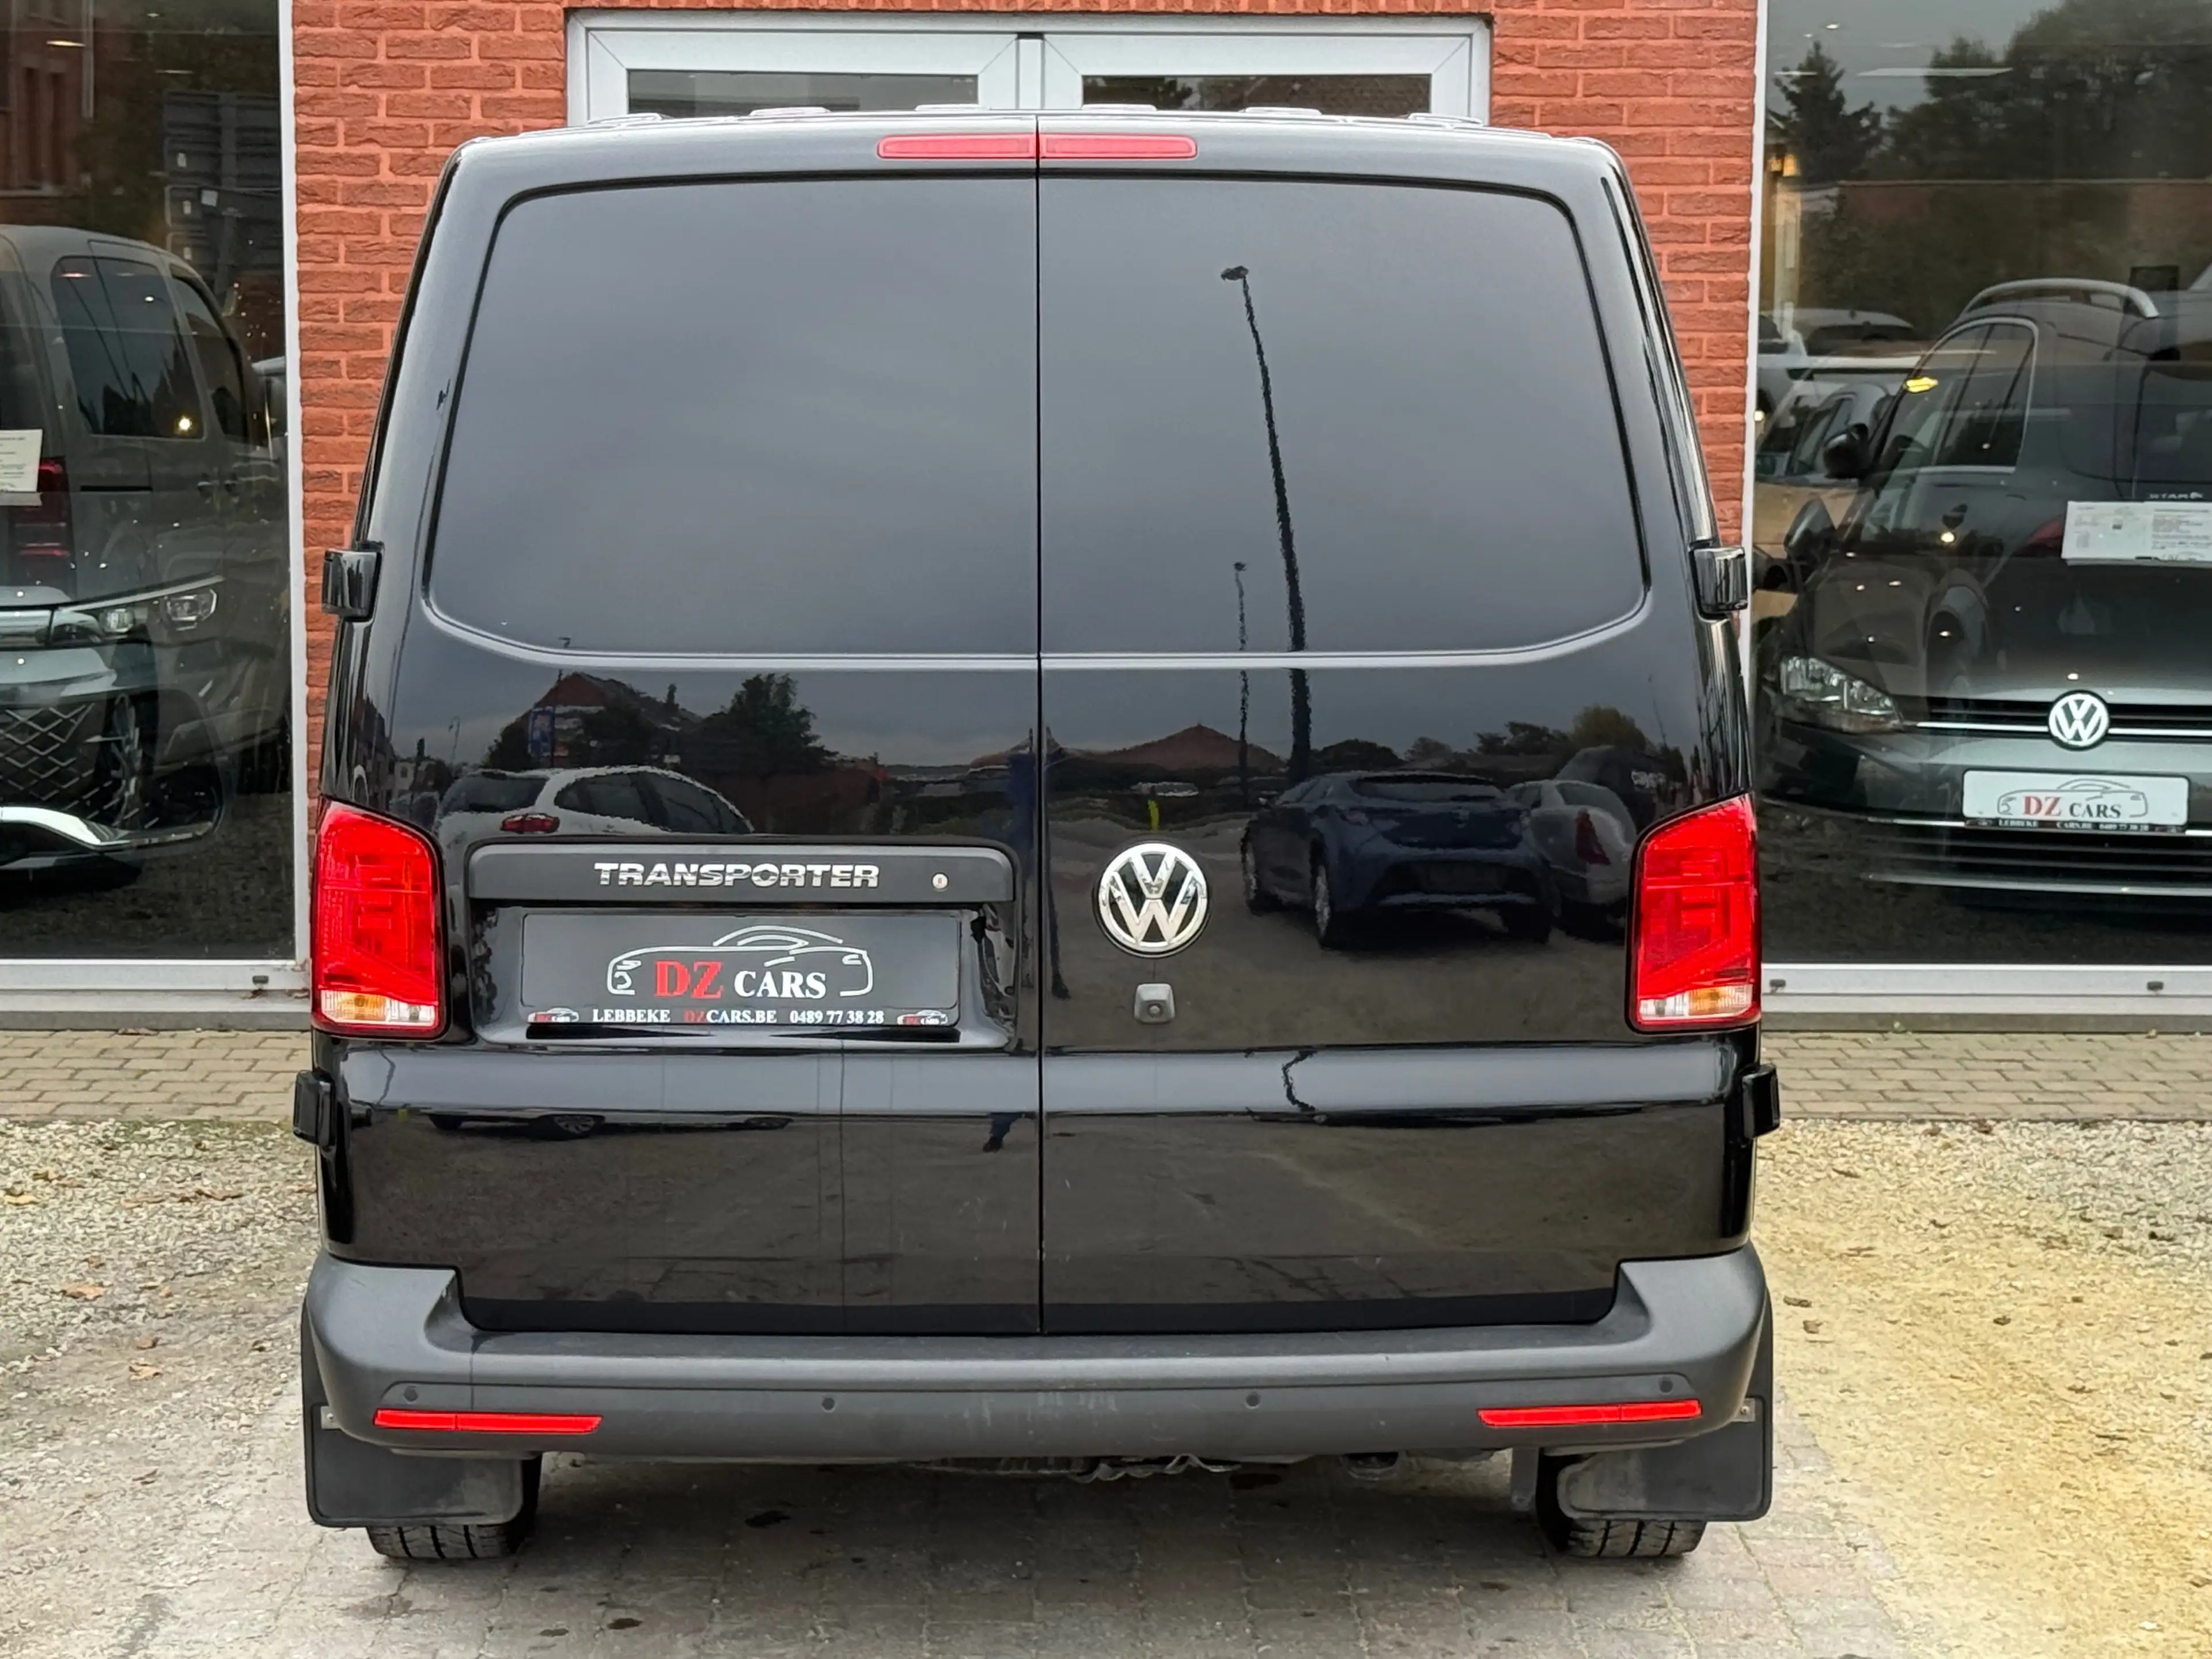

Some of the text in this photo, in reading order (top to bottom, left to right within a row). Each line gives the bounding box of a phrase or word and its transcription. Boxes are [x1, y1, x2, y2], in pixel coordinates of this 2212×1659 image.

[2023, 796, 2122, 819] DZ CARS
[594, 863, 880, 888] TRANSPORTER
[654, 961, 826, 999] DZ CARS
[592, 1009, 885, 1024] LEBBEKE DZCARS.BE 0489 77 38 28
